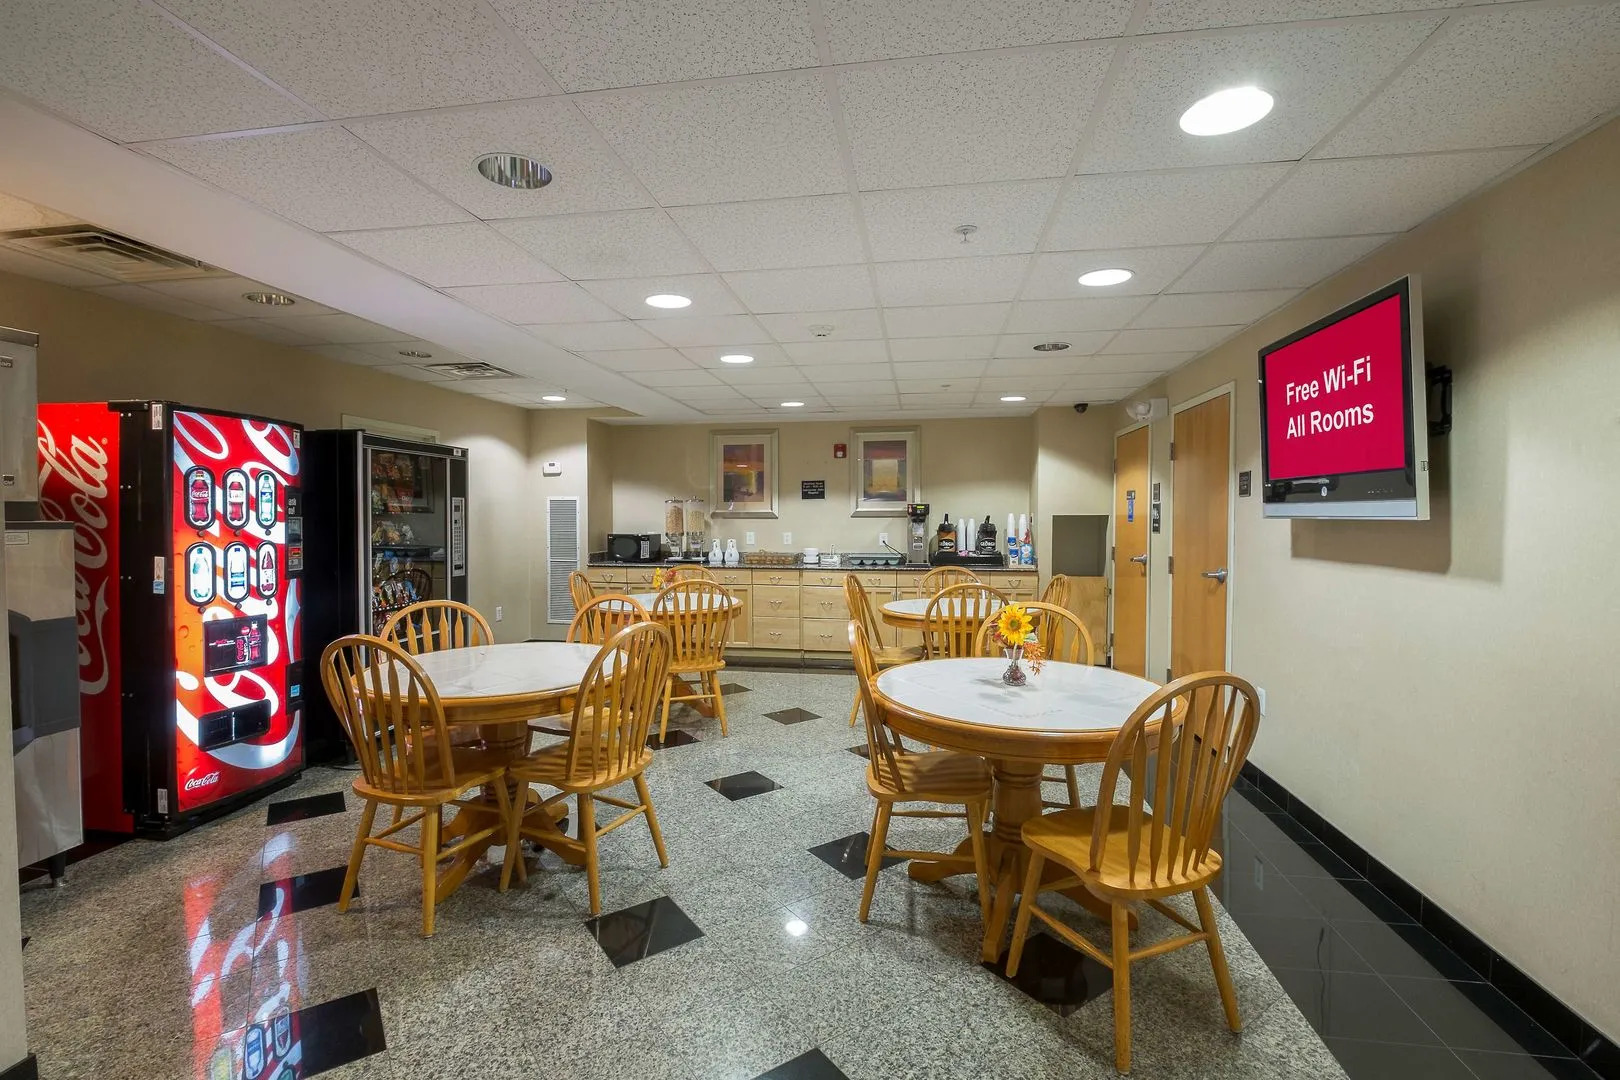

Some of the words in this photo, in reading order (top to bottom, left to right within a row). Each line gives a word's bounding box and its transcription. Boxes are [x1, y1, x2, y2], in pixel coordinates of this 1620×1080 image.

[1286, 380, 1319, 405] Free
[1323, 355, 1371, 394] Wi-Fi
[1286, 414, 1306, 439] All
[1310, 403, 1374, 434] Rooms
